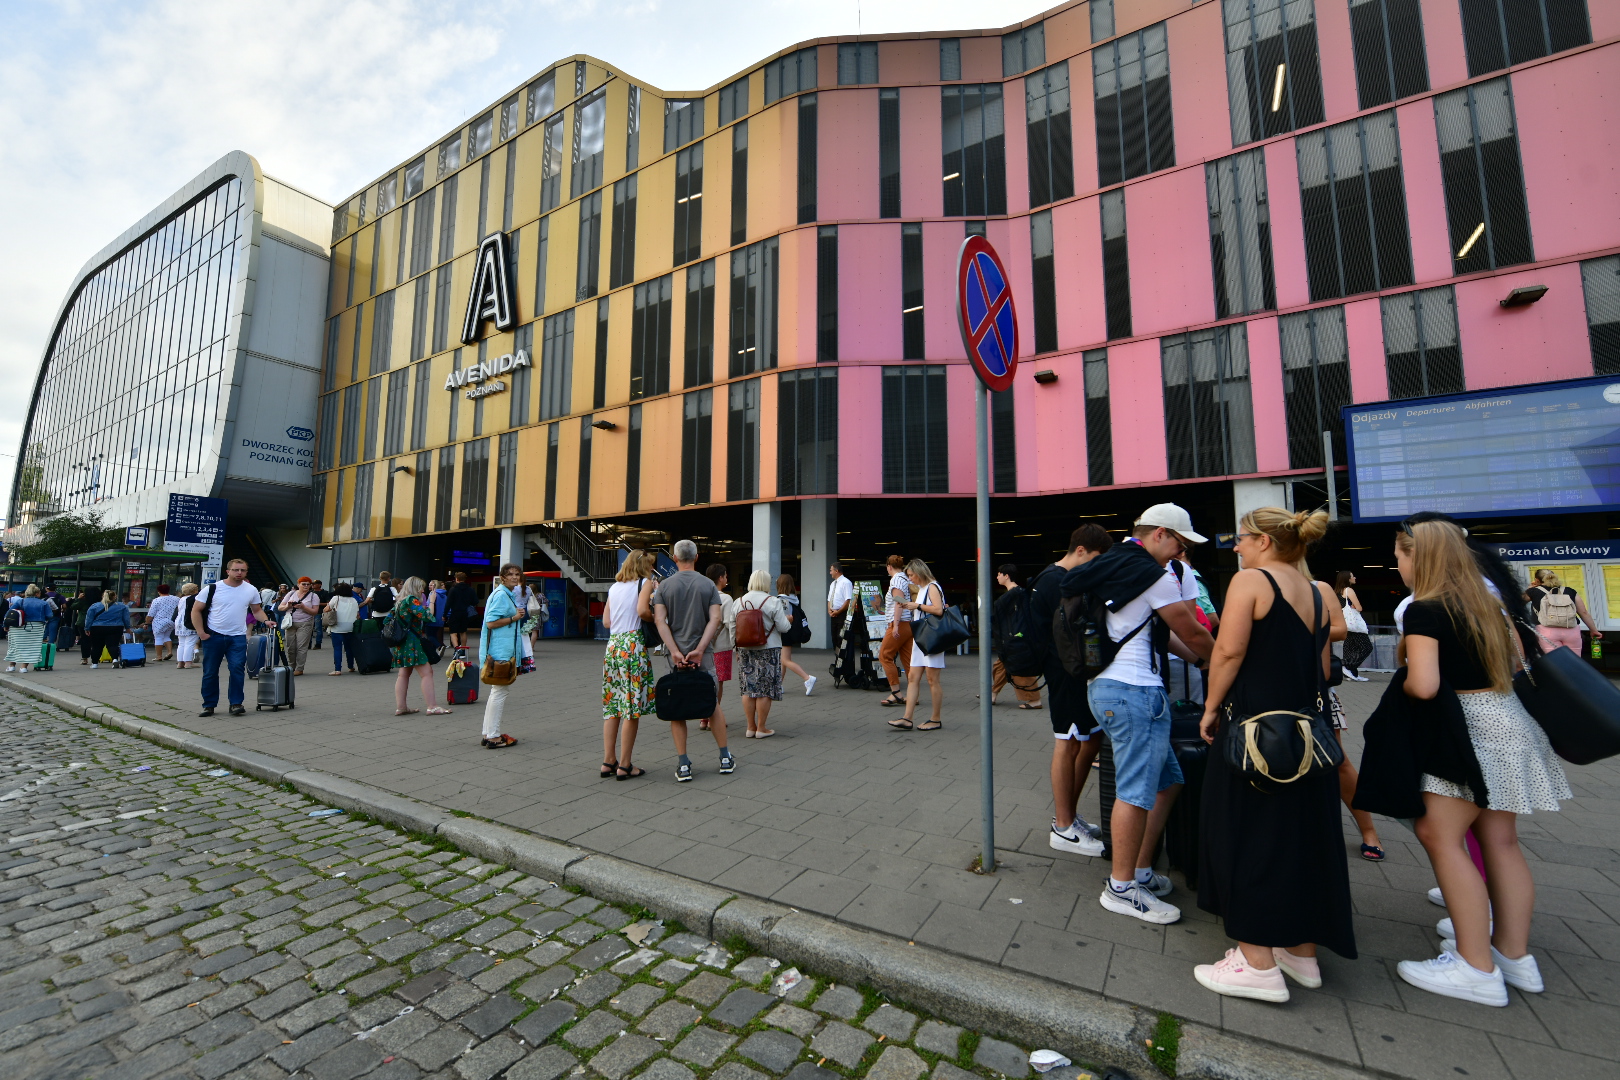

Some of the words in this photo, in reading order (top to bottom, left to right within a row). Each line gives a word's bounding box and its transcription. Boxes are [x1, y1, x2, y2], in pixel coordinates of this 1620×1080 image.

[444, 350, 531, 391] AVENIDA
[466, 380, 504, 400] POZNAŃ
[1351, 411, 1398, 423] Odjazdy
[1406, 406, 1456, 417] Departures
[1464, 399, 1512, 411] Abfahrten
[291, 429, 311, 438] PKP
[242, 439, 294, 454] DWORZEC
[249, 452, 294, 465] POZNAŃ
[1498, 546, 1550, 556] Poznań
[1554, 545, 1611, 556] Główny
